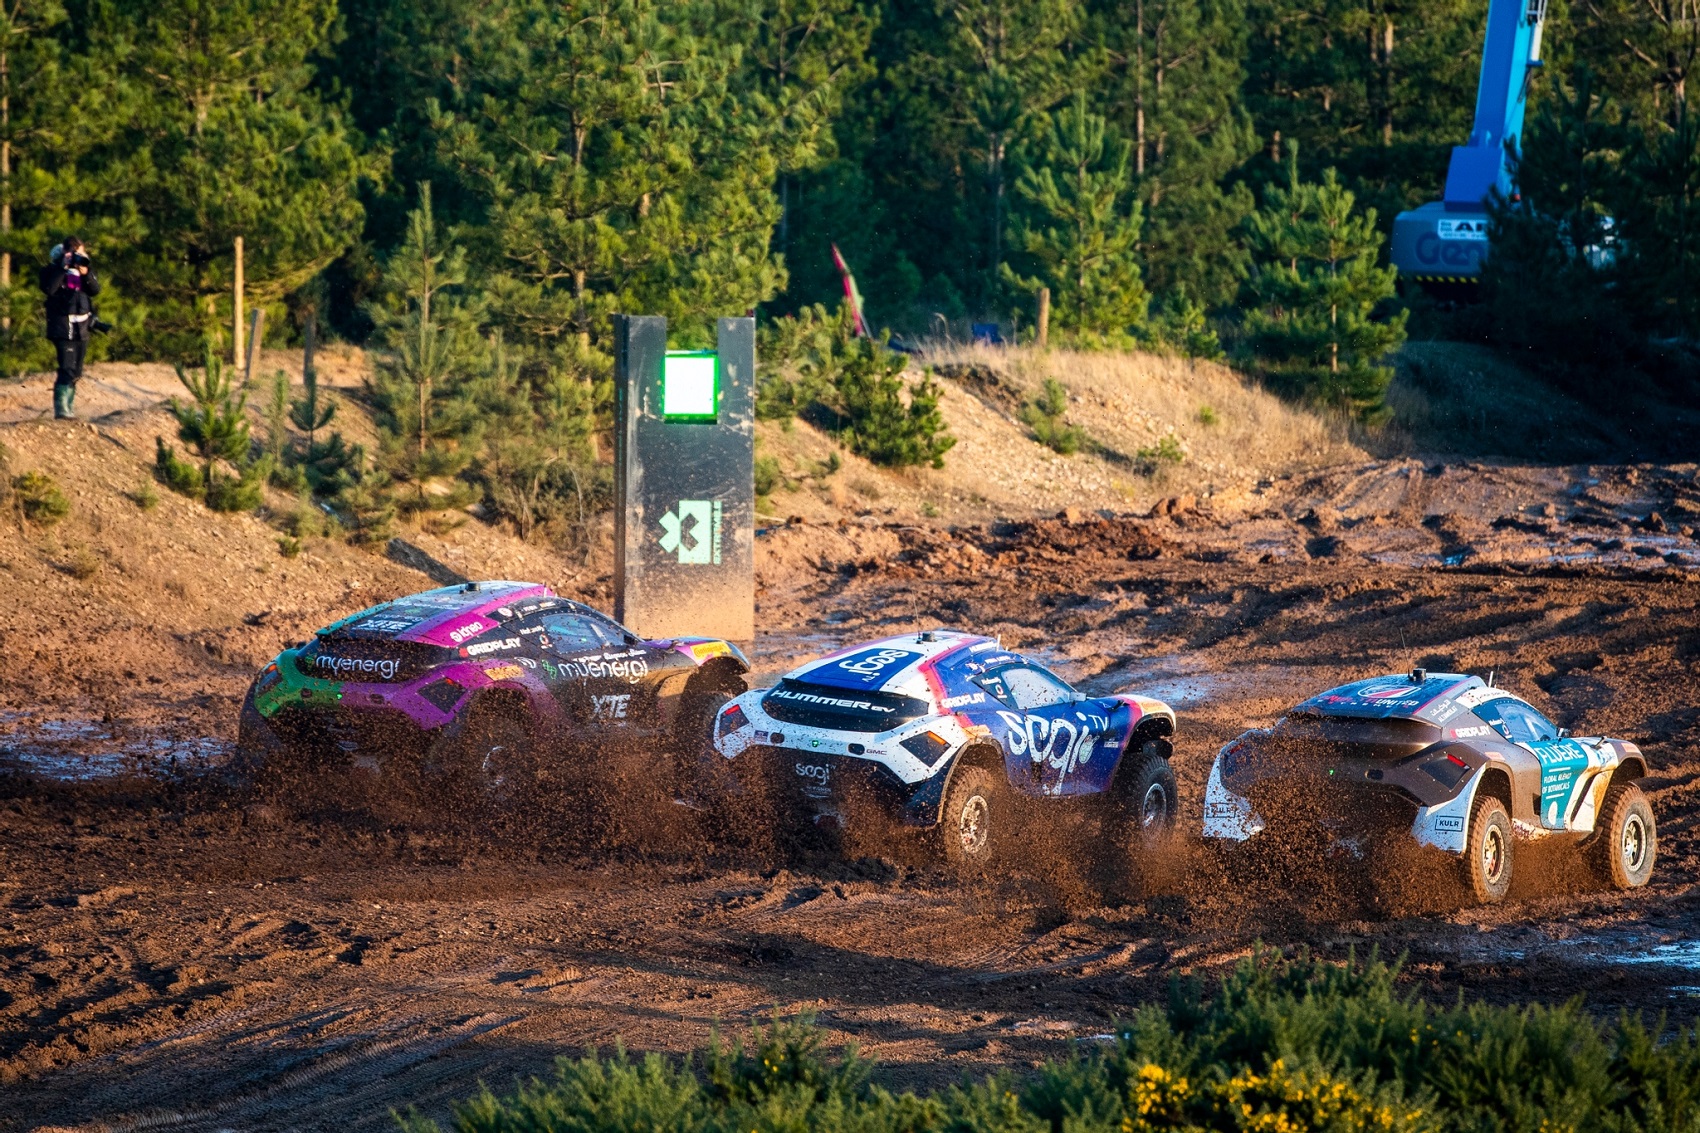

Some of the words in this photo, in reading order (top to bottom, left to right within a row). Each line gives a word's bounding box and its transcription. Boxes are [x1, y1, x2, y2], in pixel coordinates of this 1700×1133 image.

[466, 637, 521, 656] GRIDPLAY
[316, 655, 400, 679] myenergi
[557, 656, 648, 687] myenergi
[838, 649, 910, 676] segi
[771, 690, 869, 710] HUMMER
[870, 705, 896, 713] EV
[941, 692, 986, 709] GRIDPLAY
[1088, 714, 1108, 732] TV
[1455, 724, 1491, 739] GRIDPLAY
[866, 748, 888, 756] GMC
[795, 763, 831, 786] segi
[1557, 772, 1572, 781] BLEND
